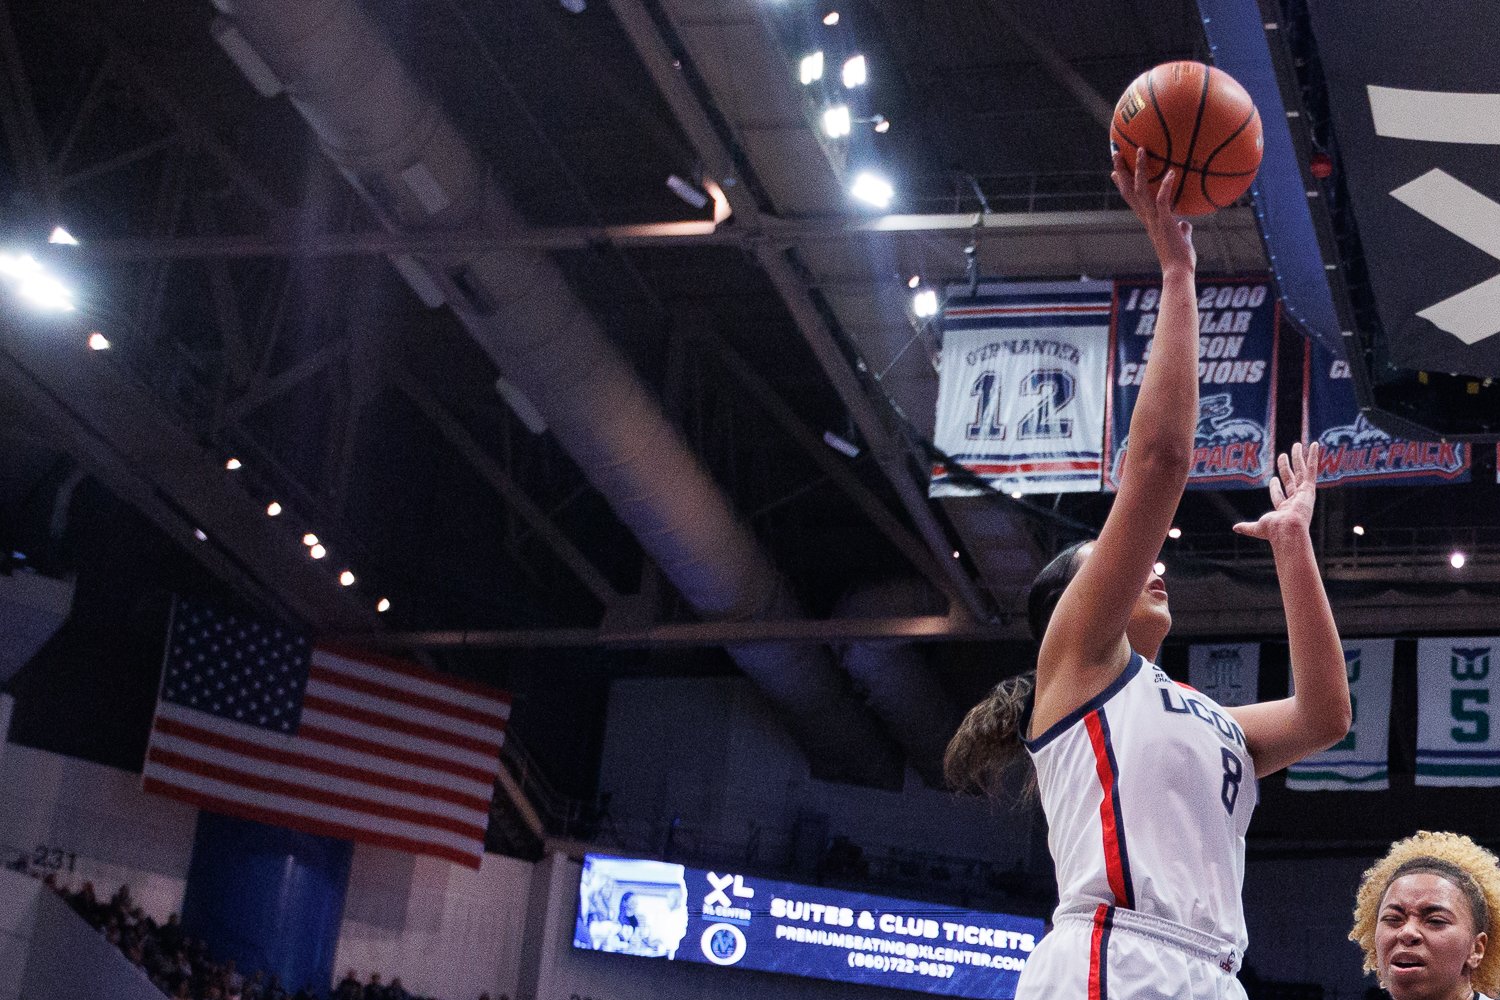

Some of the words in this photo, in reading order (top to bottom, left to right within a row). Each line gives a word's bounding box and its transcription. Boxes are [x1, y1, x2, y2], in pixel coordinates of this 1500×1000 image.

[1125, 285, 1267, 311] 192000
[1135, 311, 1252, 335] RLAR
[1143, 336, 1244, 359] SSON
[965, 368, 1076, 440] 12
[1159, 687, 1248, 748] UCON
[1450, 688, 1491, 744] 5
[1221, 746, 1243, 816] 8
[703, 871, 754, 907] XL
[770, 898, 854, 927] SUITES
[857, 911, 876, 930] &
[879, 914, 940, 939] CLUB
[942, 922, 1035, 952] TICKETS
